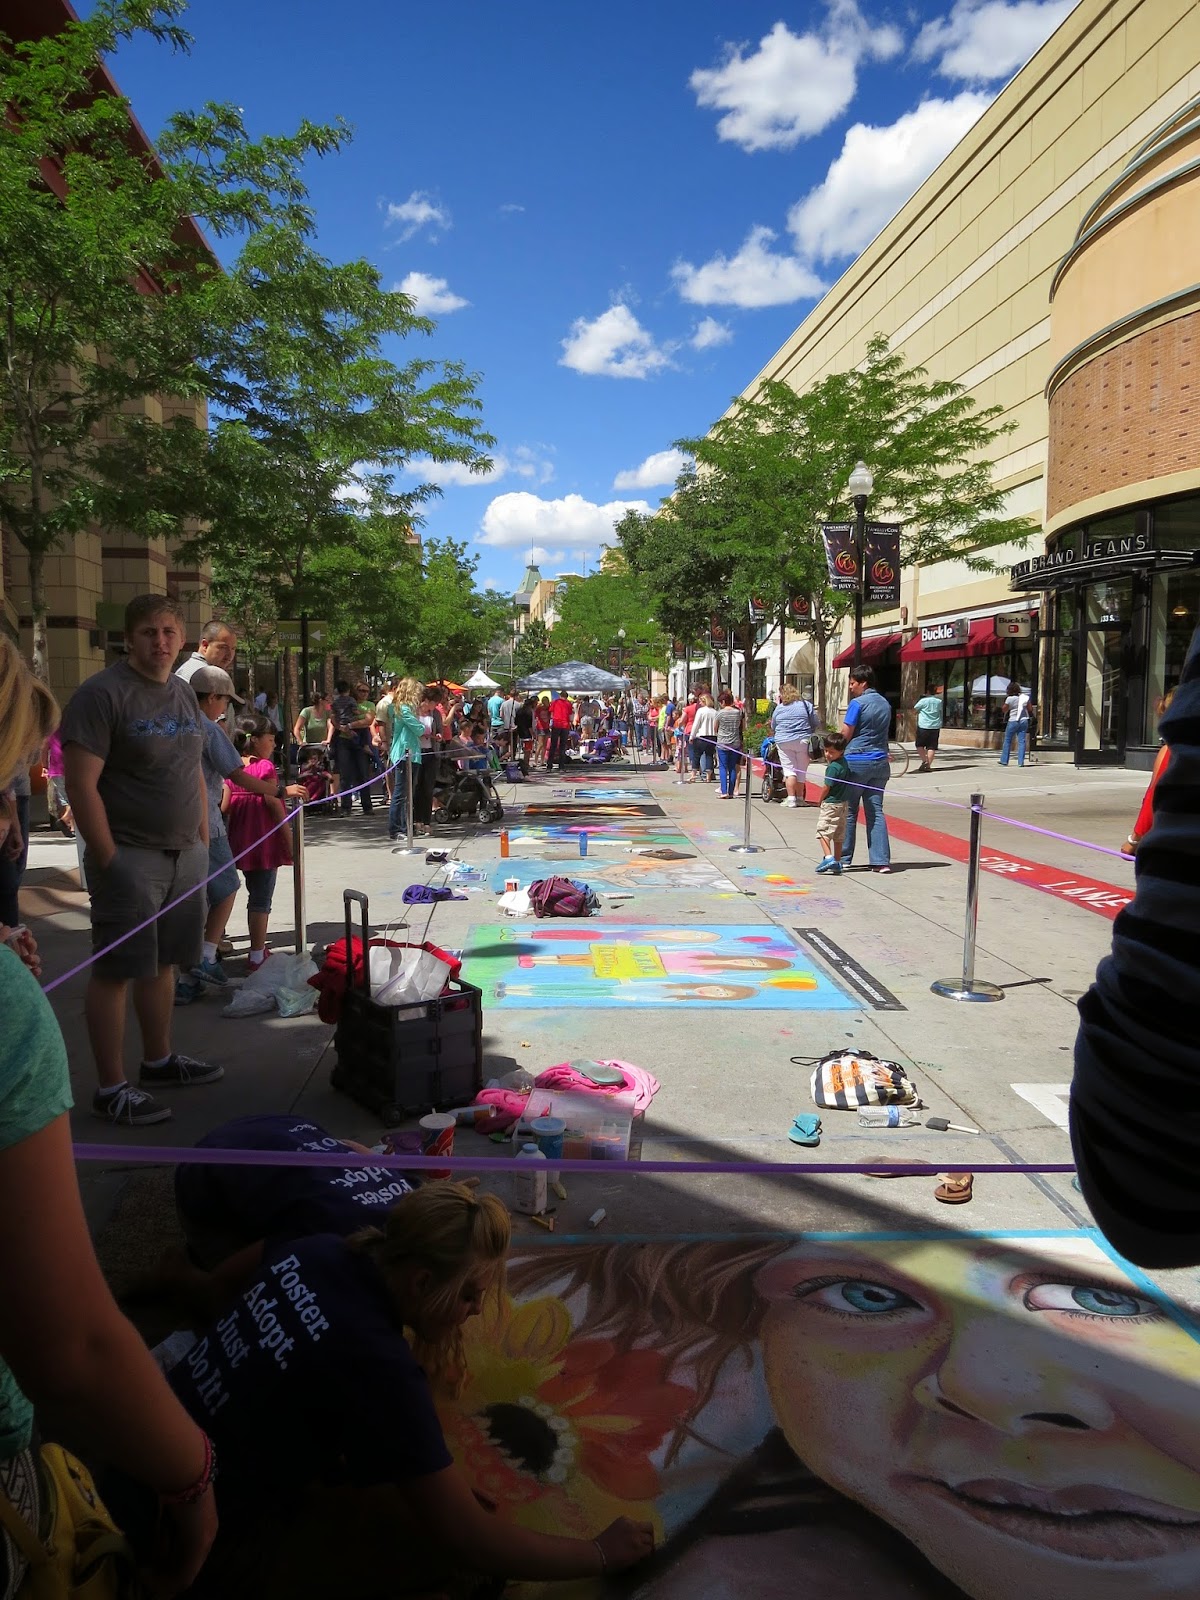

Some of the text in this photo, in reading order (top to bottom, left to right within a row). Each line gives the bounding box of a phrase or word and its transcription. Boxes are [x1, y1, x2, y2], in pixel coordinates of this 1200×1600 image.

[1031, 549, 1074, 571] BRAND
[1083, 535, 1146, 559] JEANS
[921, 624, 953, 641] Buckle
[1039, 880, 1132, 908] LANE
[270, 1253, 330, 1342] Foster.
[216, 1310, 250, 1369] Just
[243, 1281, 296, 1371] Adopt.
